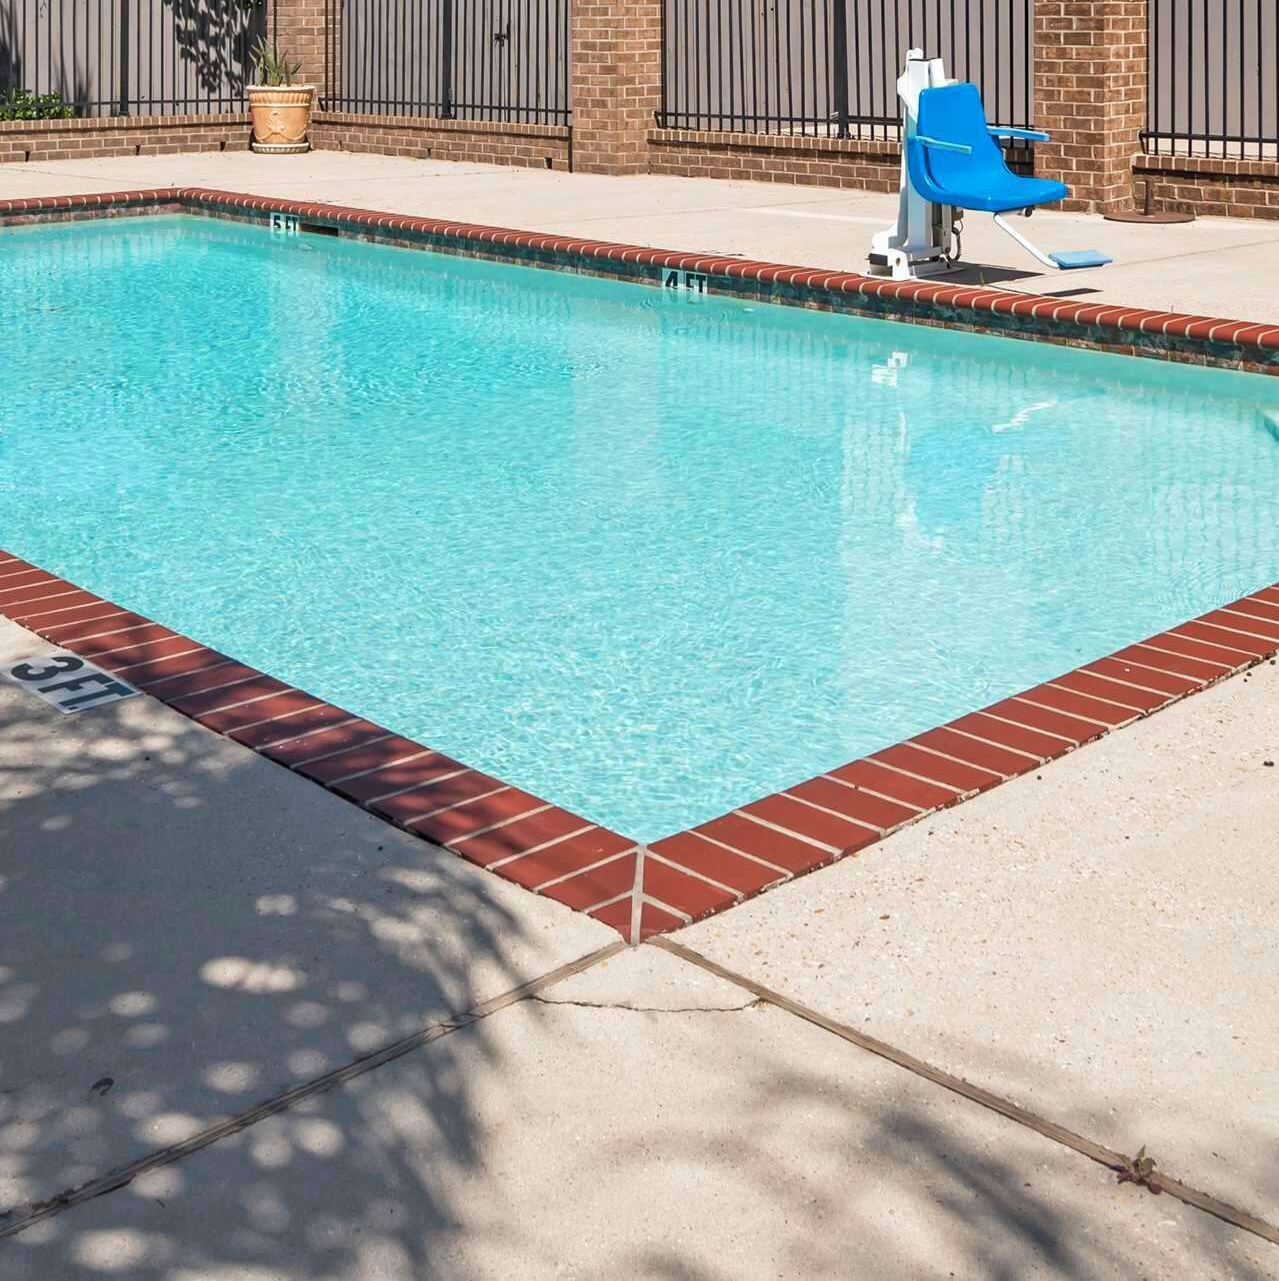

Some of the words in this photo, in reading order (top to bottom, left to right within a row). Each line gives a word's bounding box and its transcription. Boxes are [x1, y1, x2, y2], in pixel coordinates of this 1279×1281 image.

[273, 214, 281, 229] 5
[285, 215, 298, 231] FT
[665, 270, 678, 289] 4
[685, 273, 707, 293] FT
[10, 656, 84, 681] 3
